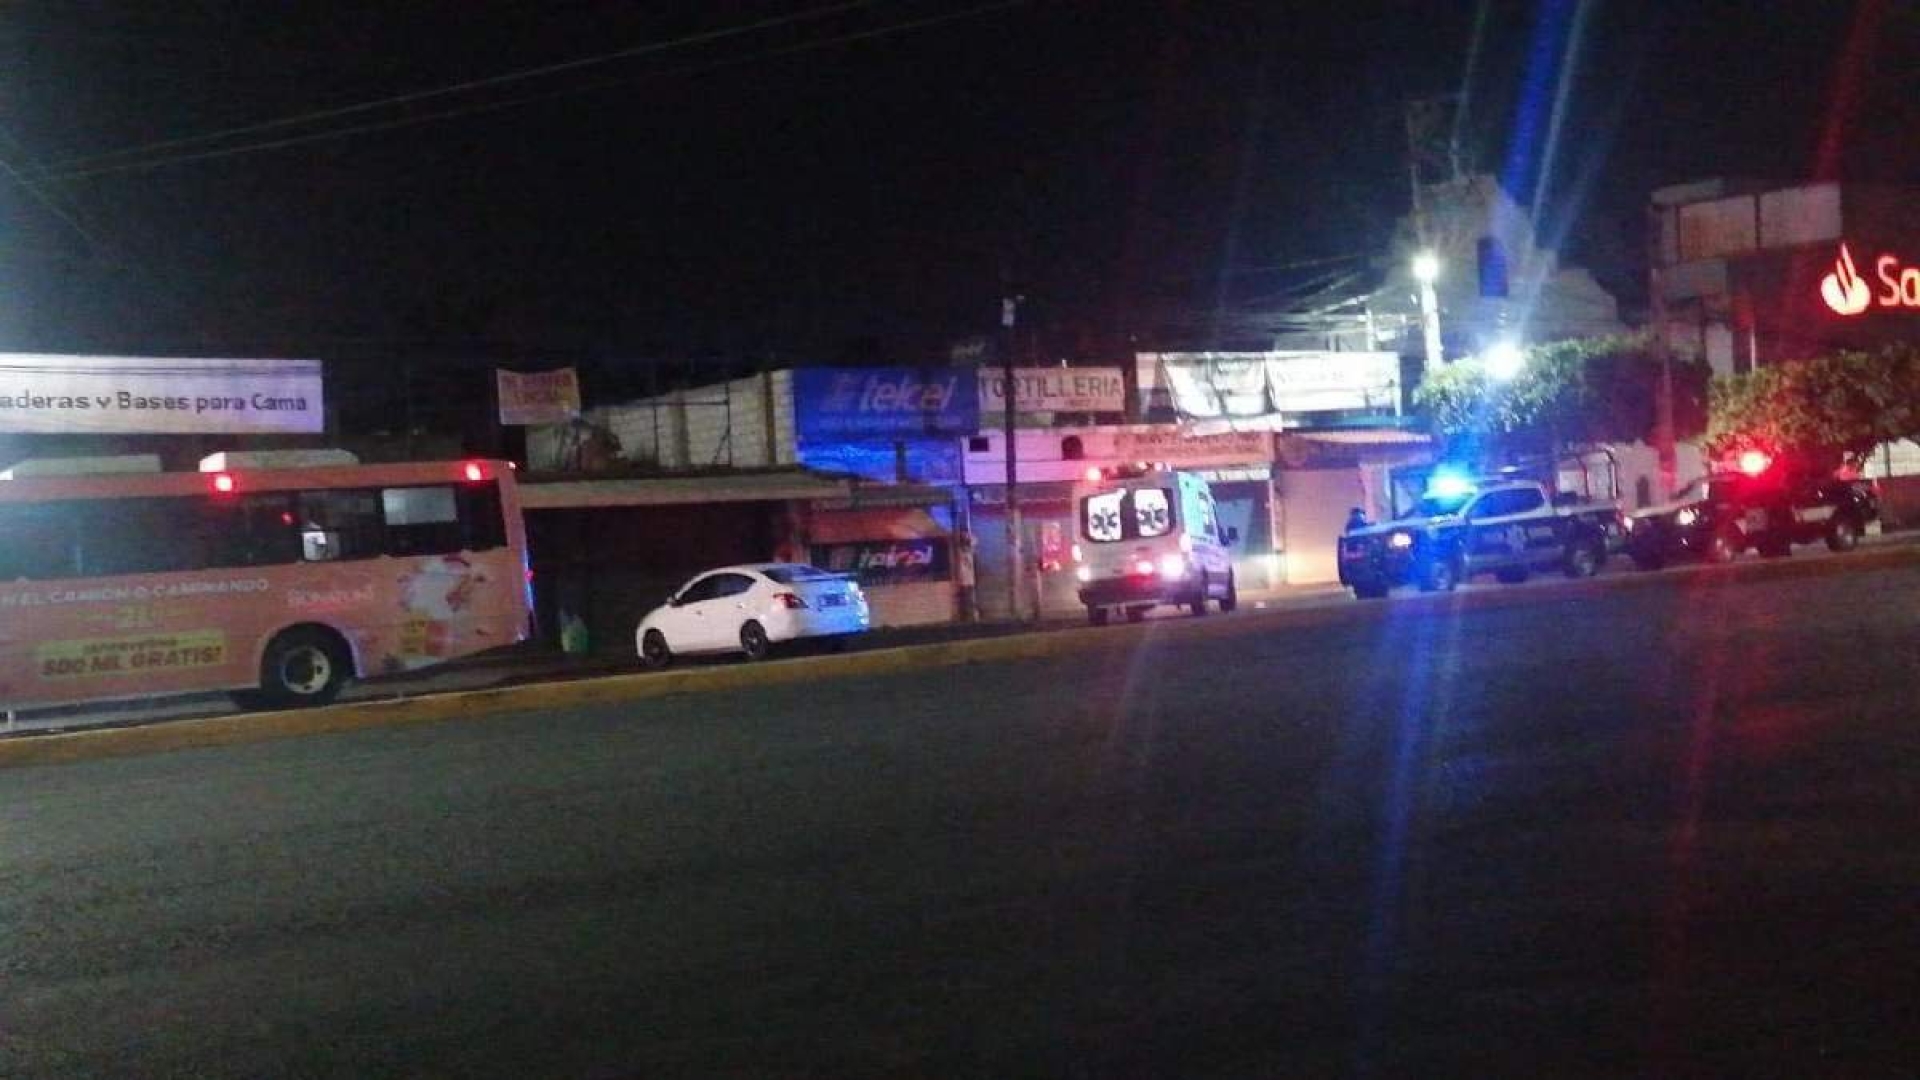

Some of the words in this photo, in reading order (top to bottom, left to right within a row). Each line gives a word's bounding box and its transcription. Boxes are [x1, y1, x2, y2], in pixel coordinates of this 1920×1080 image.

[1878, 255, 1920, 307] Sa
[117, 391, 190, 410] Bases
[197, 396, 246, 413] para
[251, 392, 307, 410] Cama
